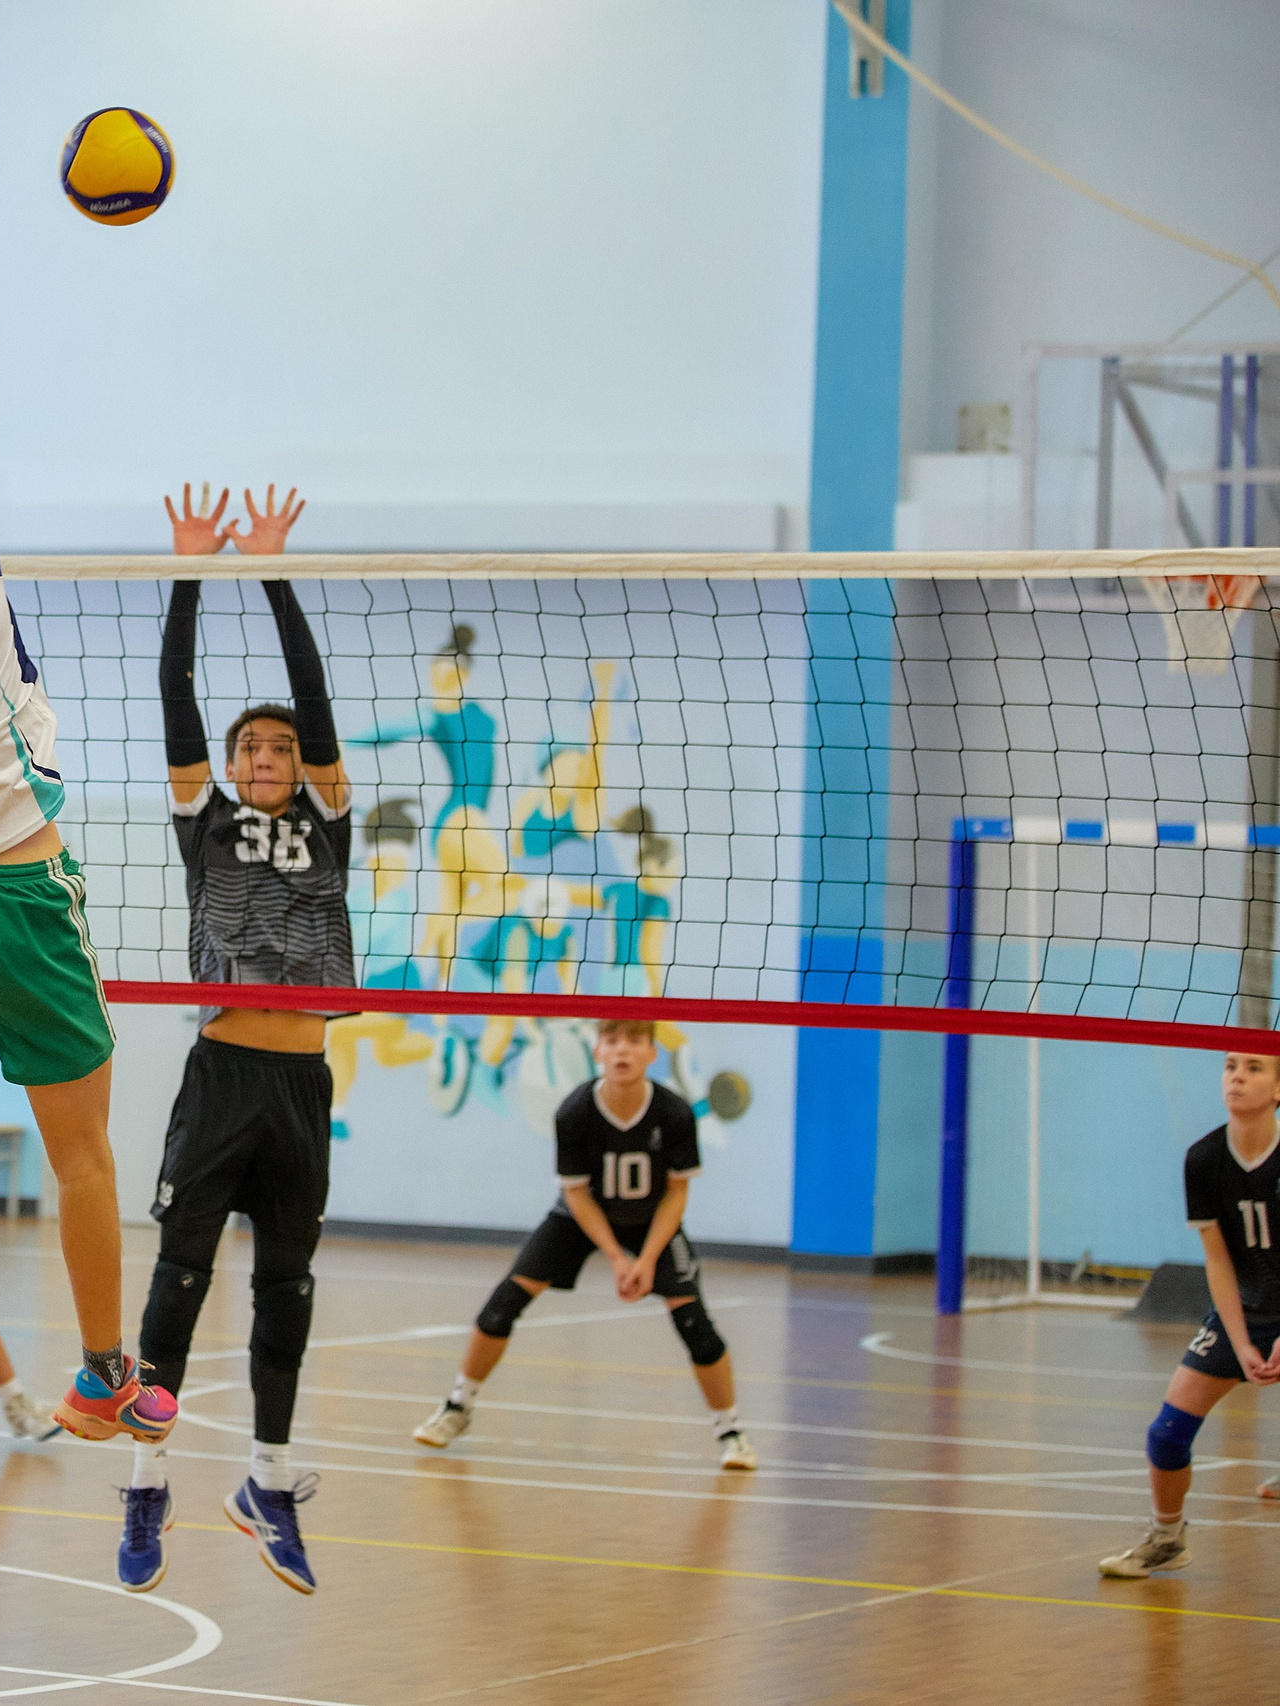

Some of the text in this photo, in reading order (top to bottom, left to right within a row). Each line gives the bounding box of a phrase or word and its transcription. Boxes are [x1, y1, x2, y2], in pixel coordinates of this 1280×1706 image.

[233, 805, 313, 873] 38
[602, 1151, 652, 1200] 10
[1238, 1200, 1271, 1249] 11
[1189, 1326, 1218, 1357] 22
